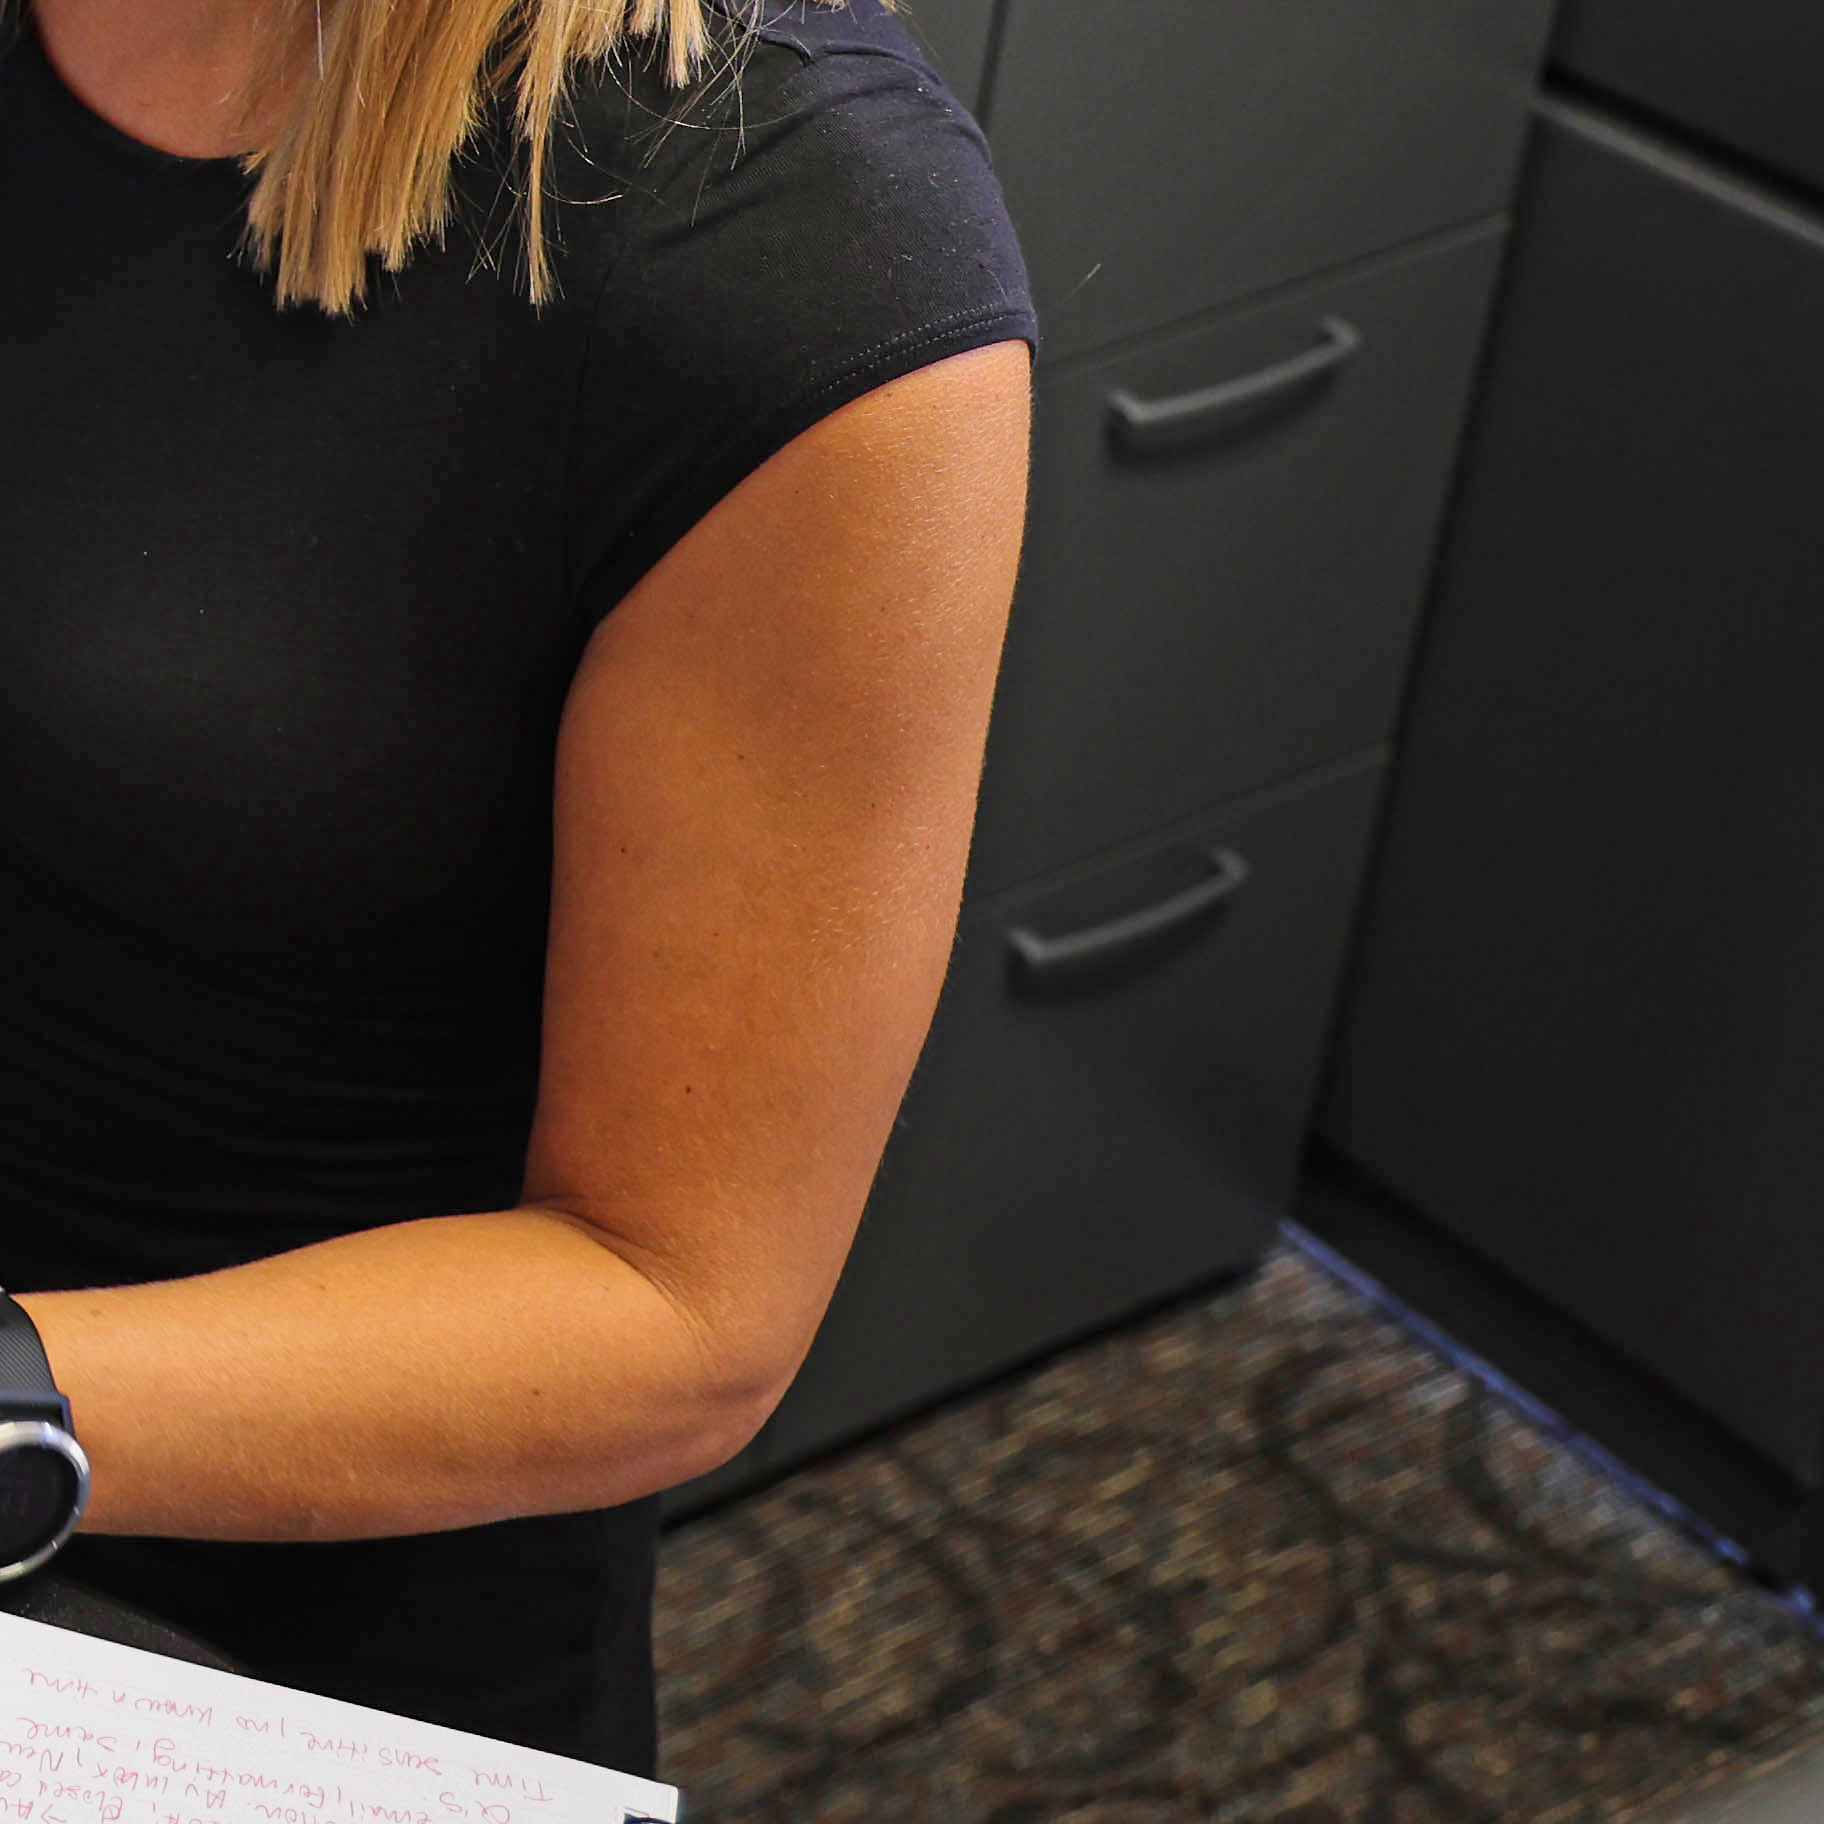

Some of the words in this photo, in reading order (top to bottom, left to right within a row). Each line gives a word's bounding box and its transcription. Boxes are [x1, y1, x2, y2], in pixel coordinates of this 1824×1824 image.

[24, 1669, 98, 1693] time
[236, 1716, 272, 1730] no
[473, 1771, 554, 1802] Time
